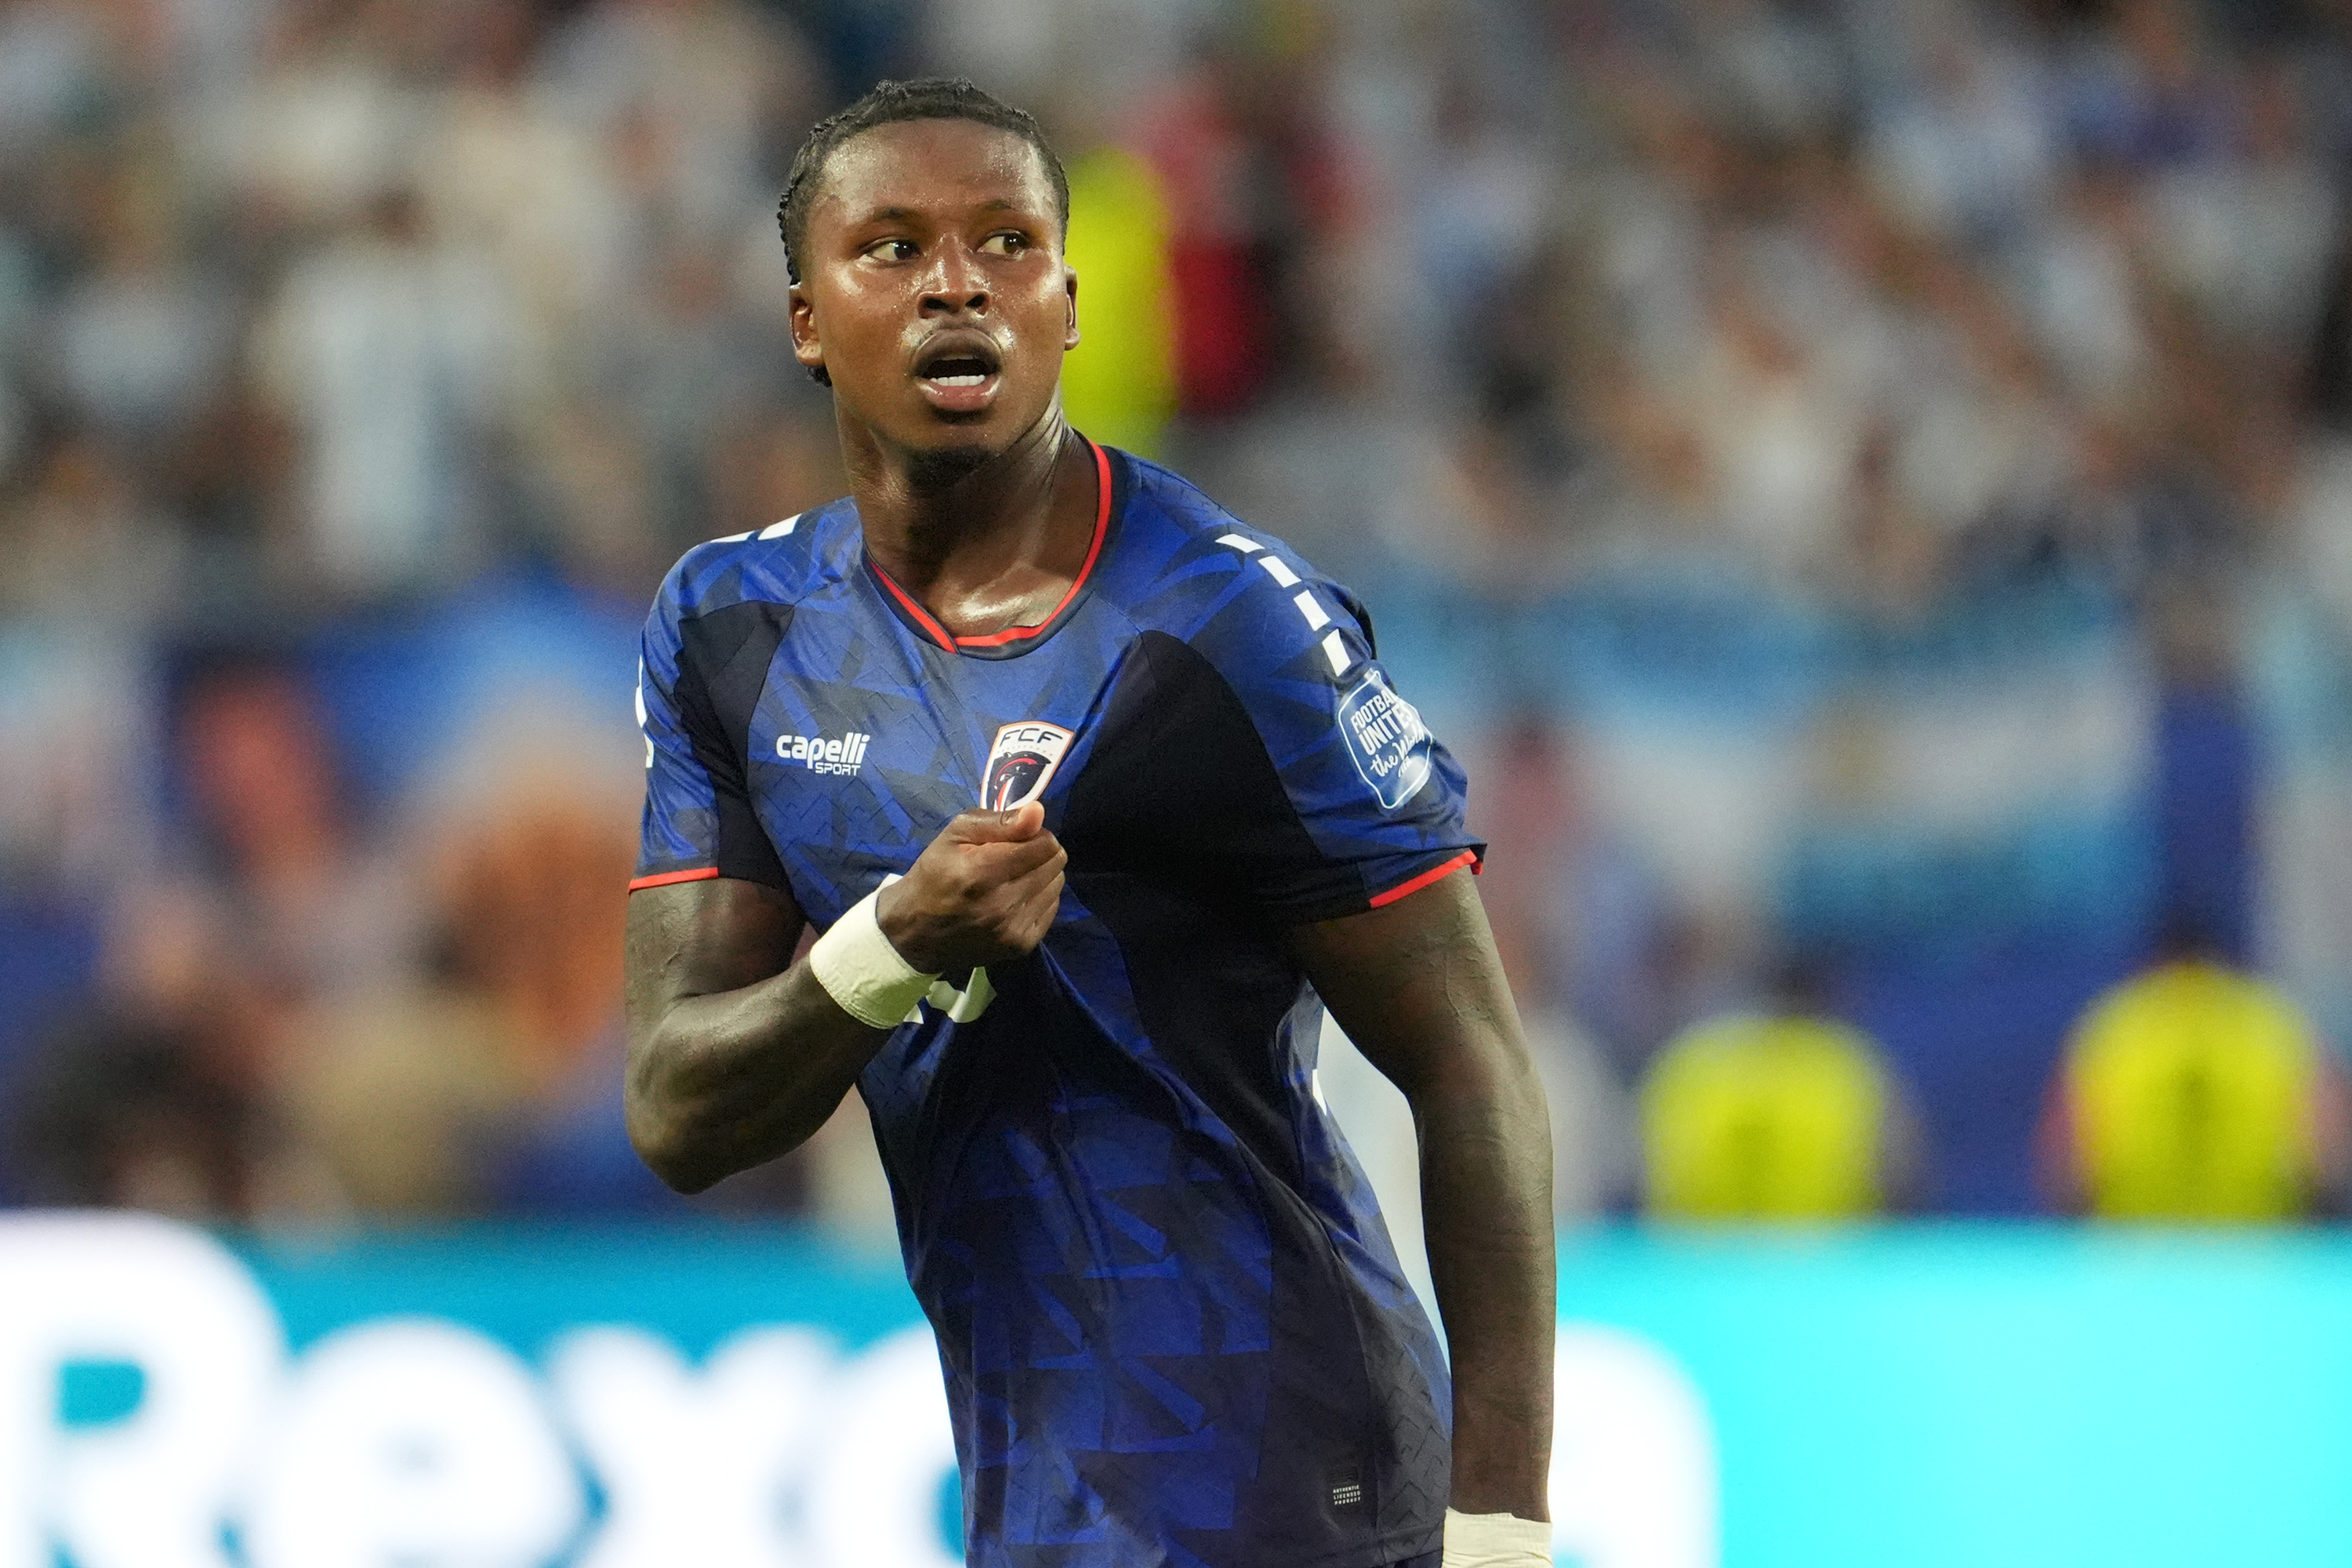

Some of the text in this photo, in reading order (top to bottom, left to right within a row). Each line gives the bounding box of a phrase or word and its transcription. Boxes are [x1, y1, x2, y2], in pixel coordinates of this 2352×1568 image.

[1350, 685, 1399, 734] FOOTBAL
[1000, 728, 1063, 747] FCF
[776, 731, 870, 769] capelli
[815, 761, 861, 776] SPORT
[1370, 753, 1399, 777] the
[1333, 1484, 1359, 1494] AUTHENTIC
[1333, 1490, 1361, 1501] LICENSED
[1334, 1496, 1361, 1505] PRODUCT
